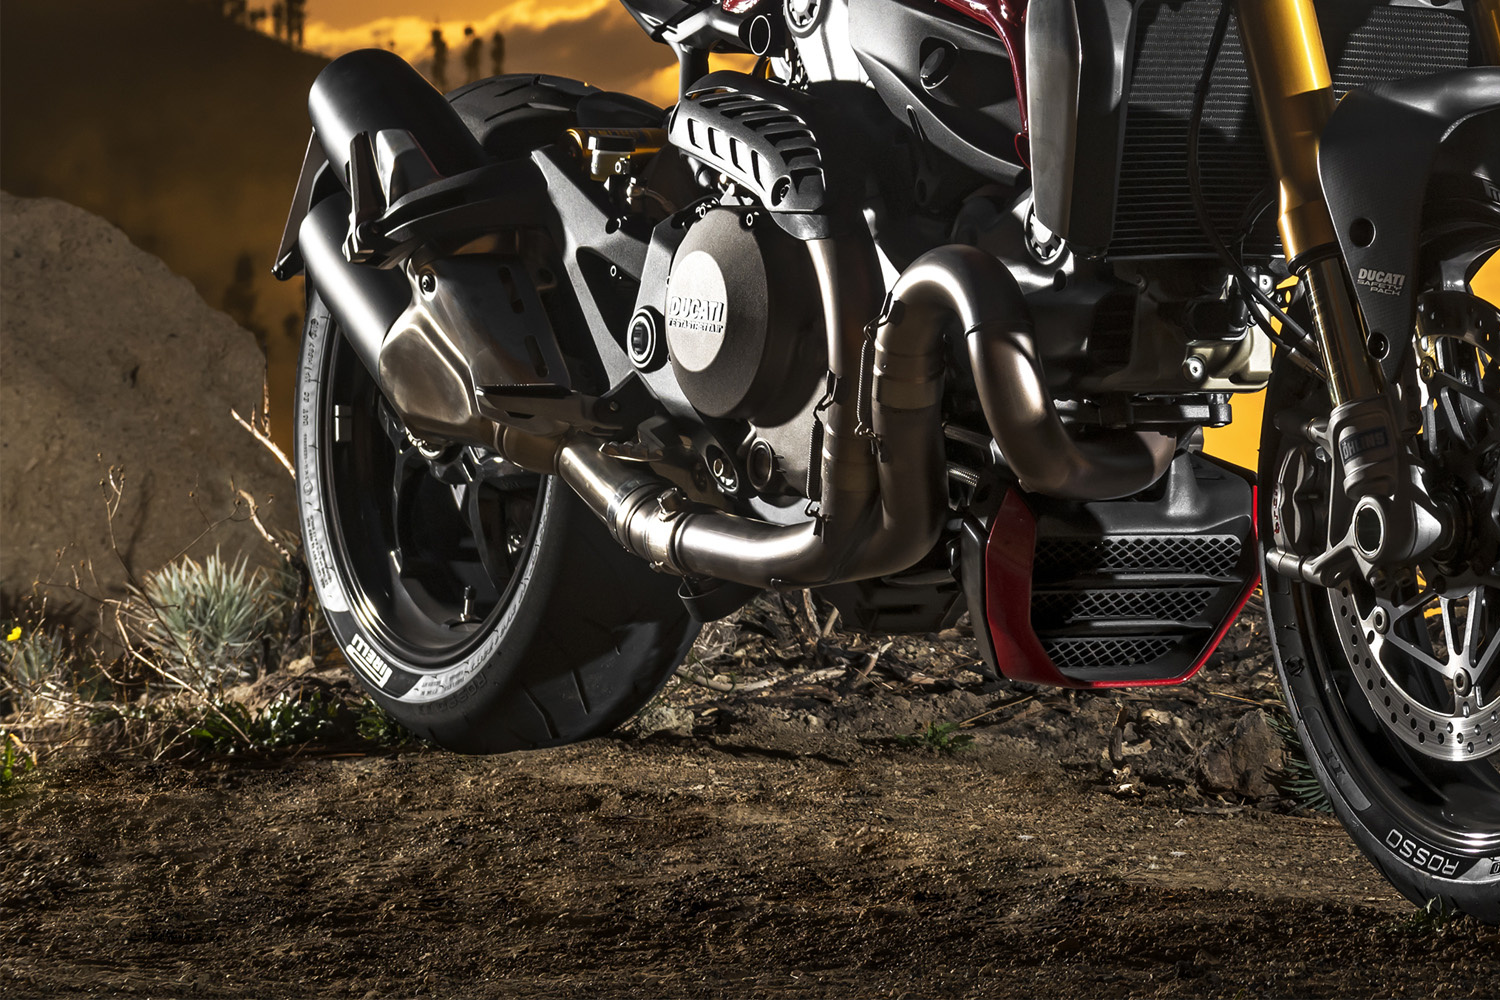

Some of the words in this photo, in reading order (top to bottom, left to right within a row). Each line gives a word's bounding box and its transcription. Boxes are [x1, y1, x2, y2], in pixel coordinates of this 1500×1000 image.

[1357, 279, 1402, 291] SAFETY
[1358, 268, 1405, 286] DUCATI
[1370, 286, 1400, 296] PACK
[669, 296, 724, 322] DUCATI
[346, 633, 393, 689] PIRELLI
[1385, 828, 1460, 876] ROSSO
